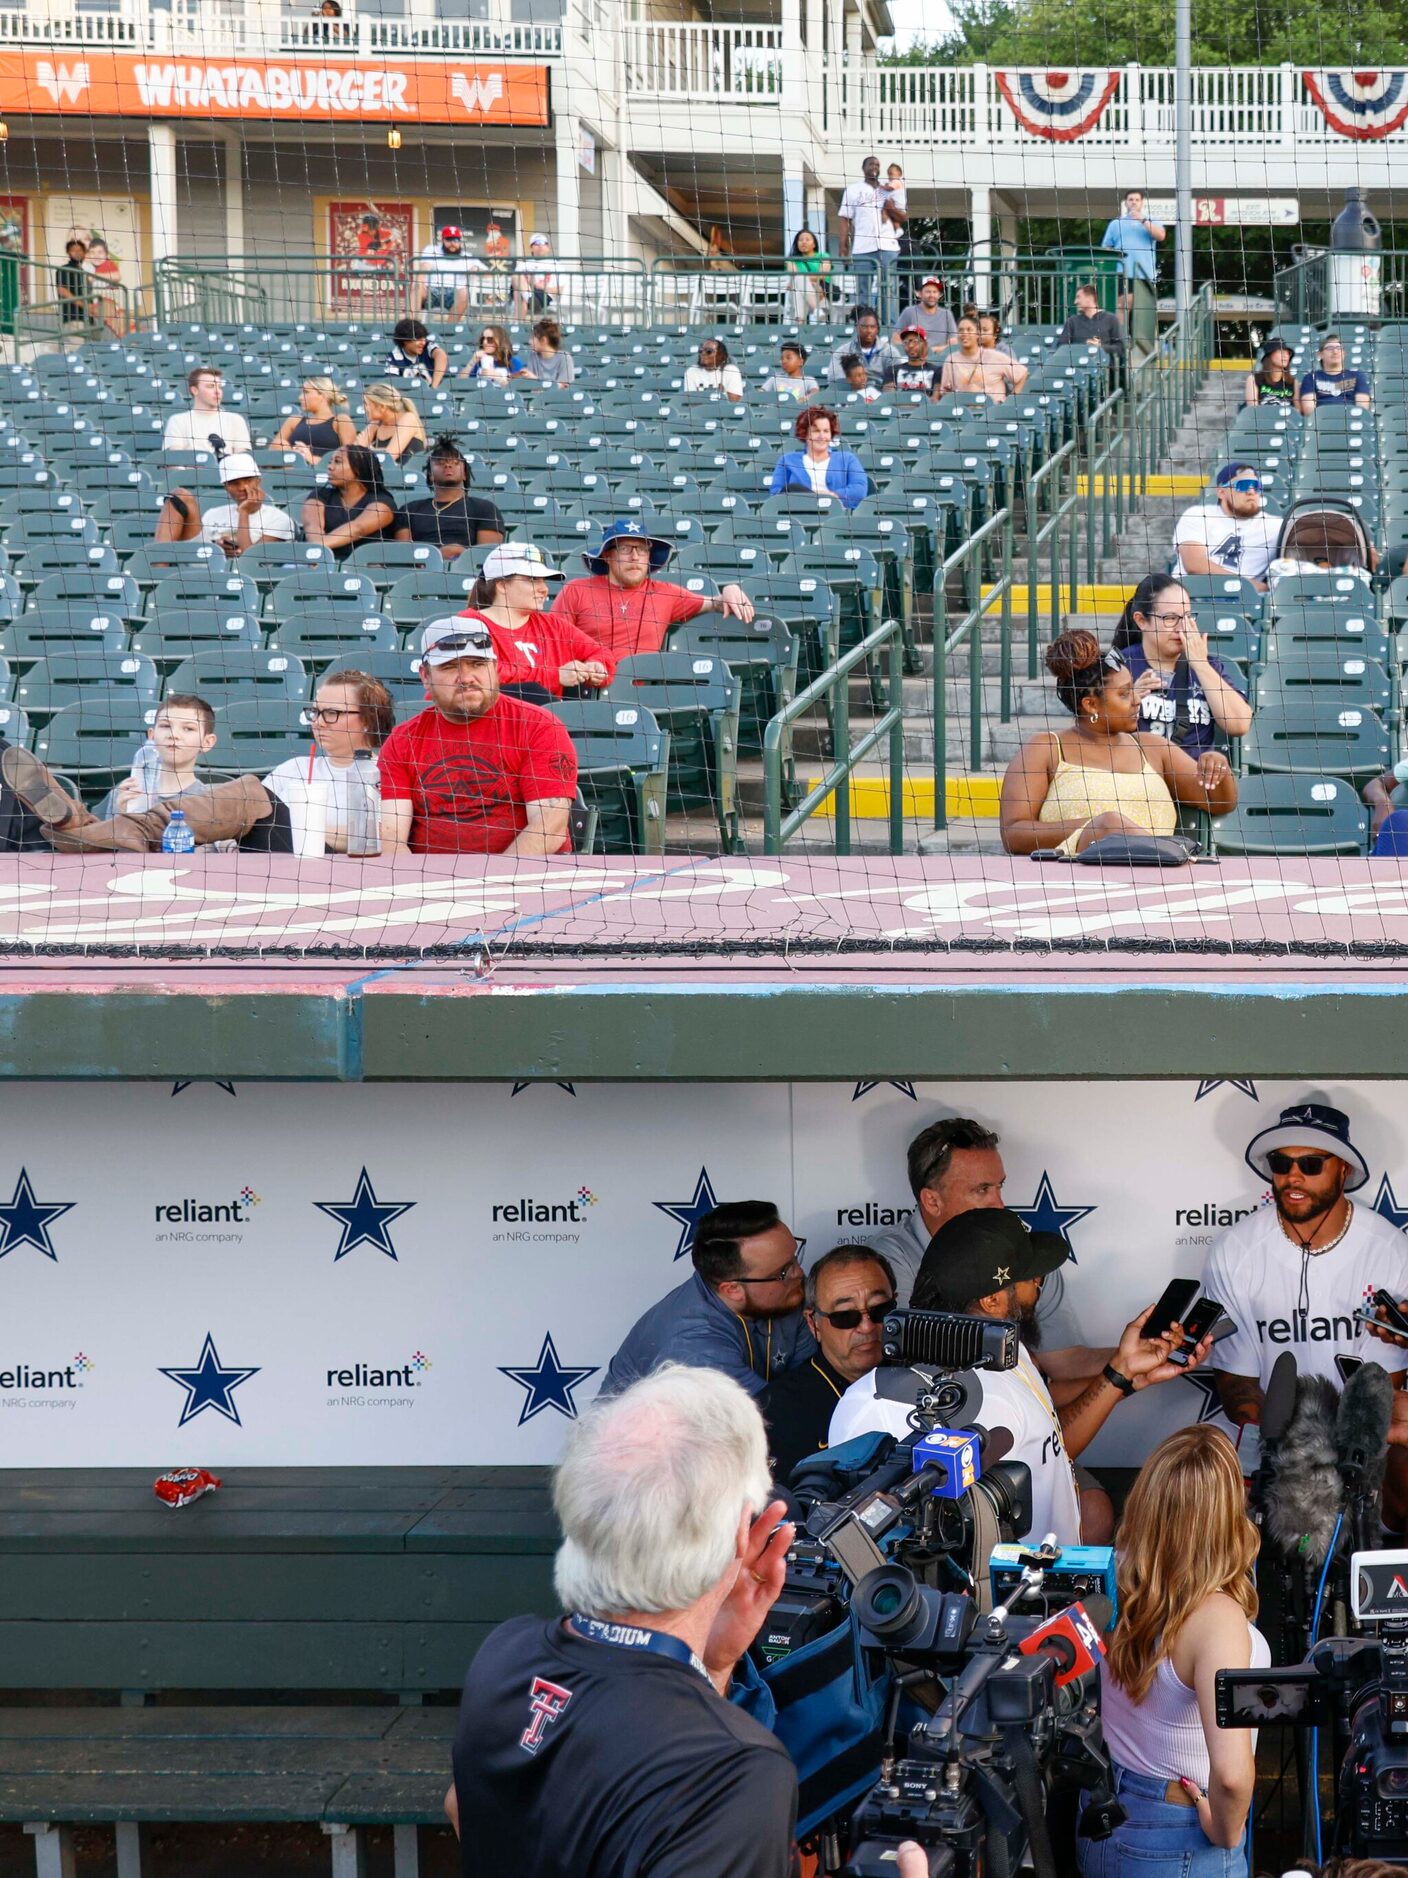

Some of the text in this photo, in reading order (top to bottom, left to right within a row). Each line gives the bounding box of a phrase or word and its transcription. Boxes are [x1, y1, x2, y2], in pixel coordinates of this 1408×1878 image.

[133, 62, 410, 112] WHATABURGER
[1207, 534, 1245, 568] 4
[169, 1232, 193, 1241] NRG
[196, 1234, 244, 1244] company
[506, 1232, 530, 1241] NRG
[533, 1234, 580, 1244] company
[0, 1364, 77, 1388] eliant
[341, 1396, 365, 1405] NRG
[368, 1398, 416, 1408] company
[1075, 1622, 1094, 1650] 4
[903, 1782, 928, 1790] SONY
